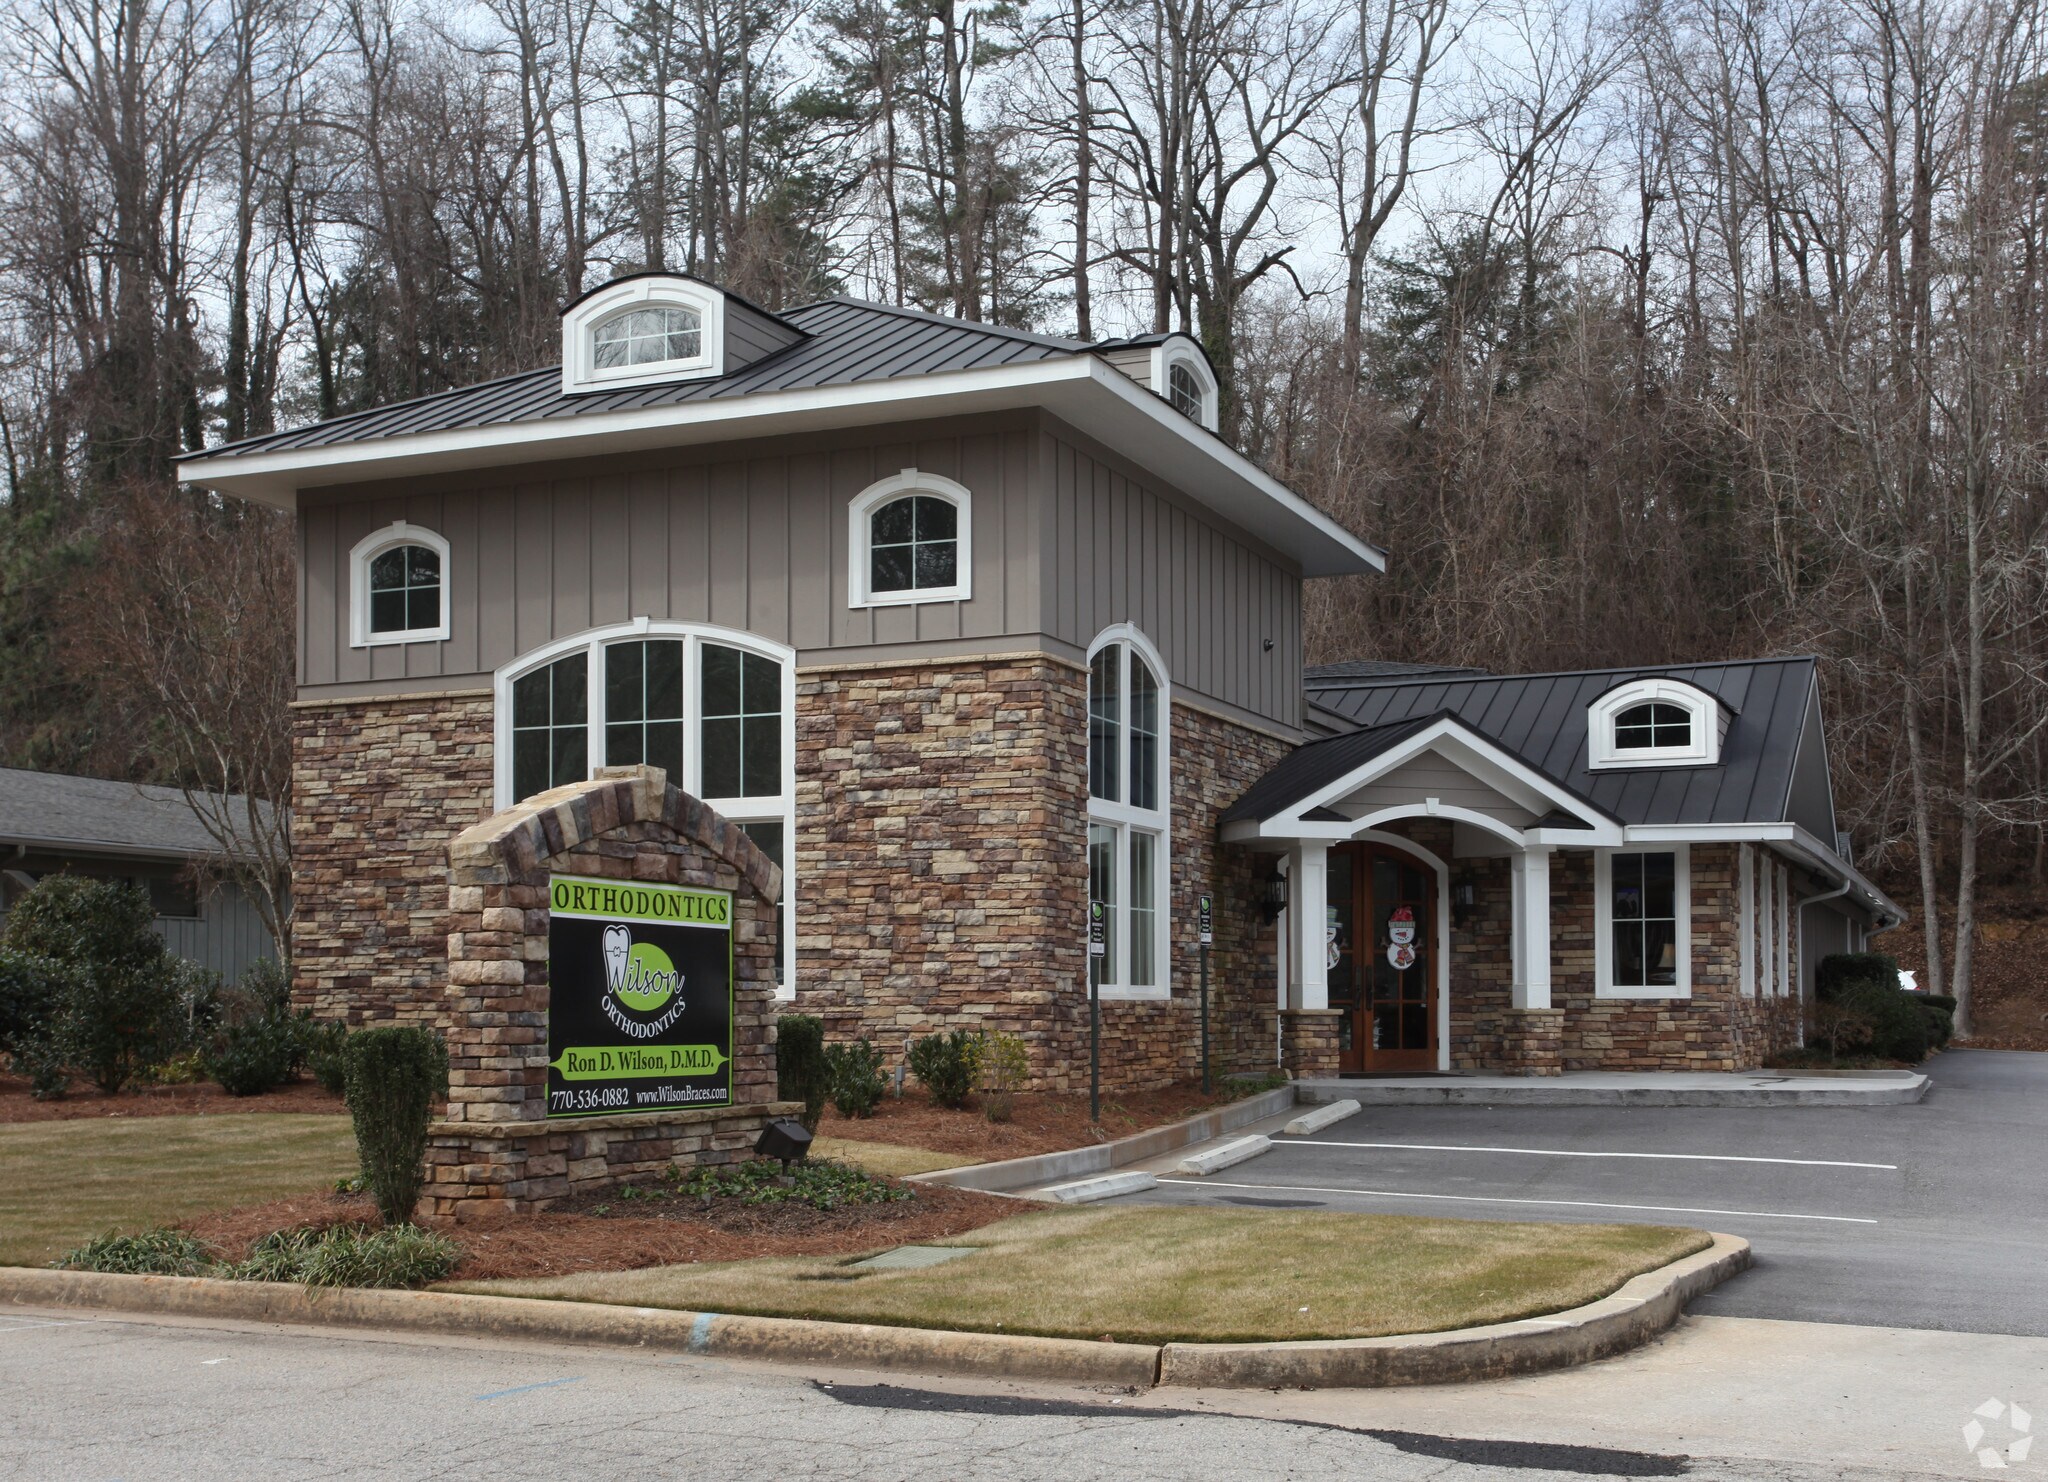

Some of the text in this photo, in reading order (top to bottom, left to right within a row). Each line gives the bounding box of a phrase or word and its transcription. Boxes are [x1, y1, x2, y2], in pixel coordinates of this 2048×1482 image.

[554, 883, 727, 921] ORTHODONTICS
[604, 952, 686, 997] Wilson
[601, 995, 686, 1039] ORTHODONTICS
[567, 1050, 714, 1073] Ron D. Wilson, D.M.D.
[551, 1084, 728, 1110] 770-536-0882 www.WilsonBraces.com
